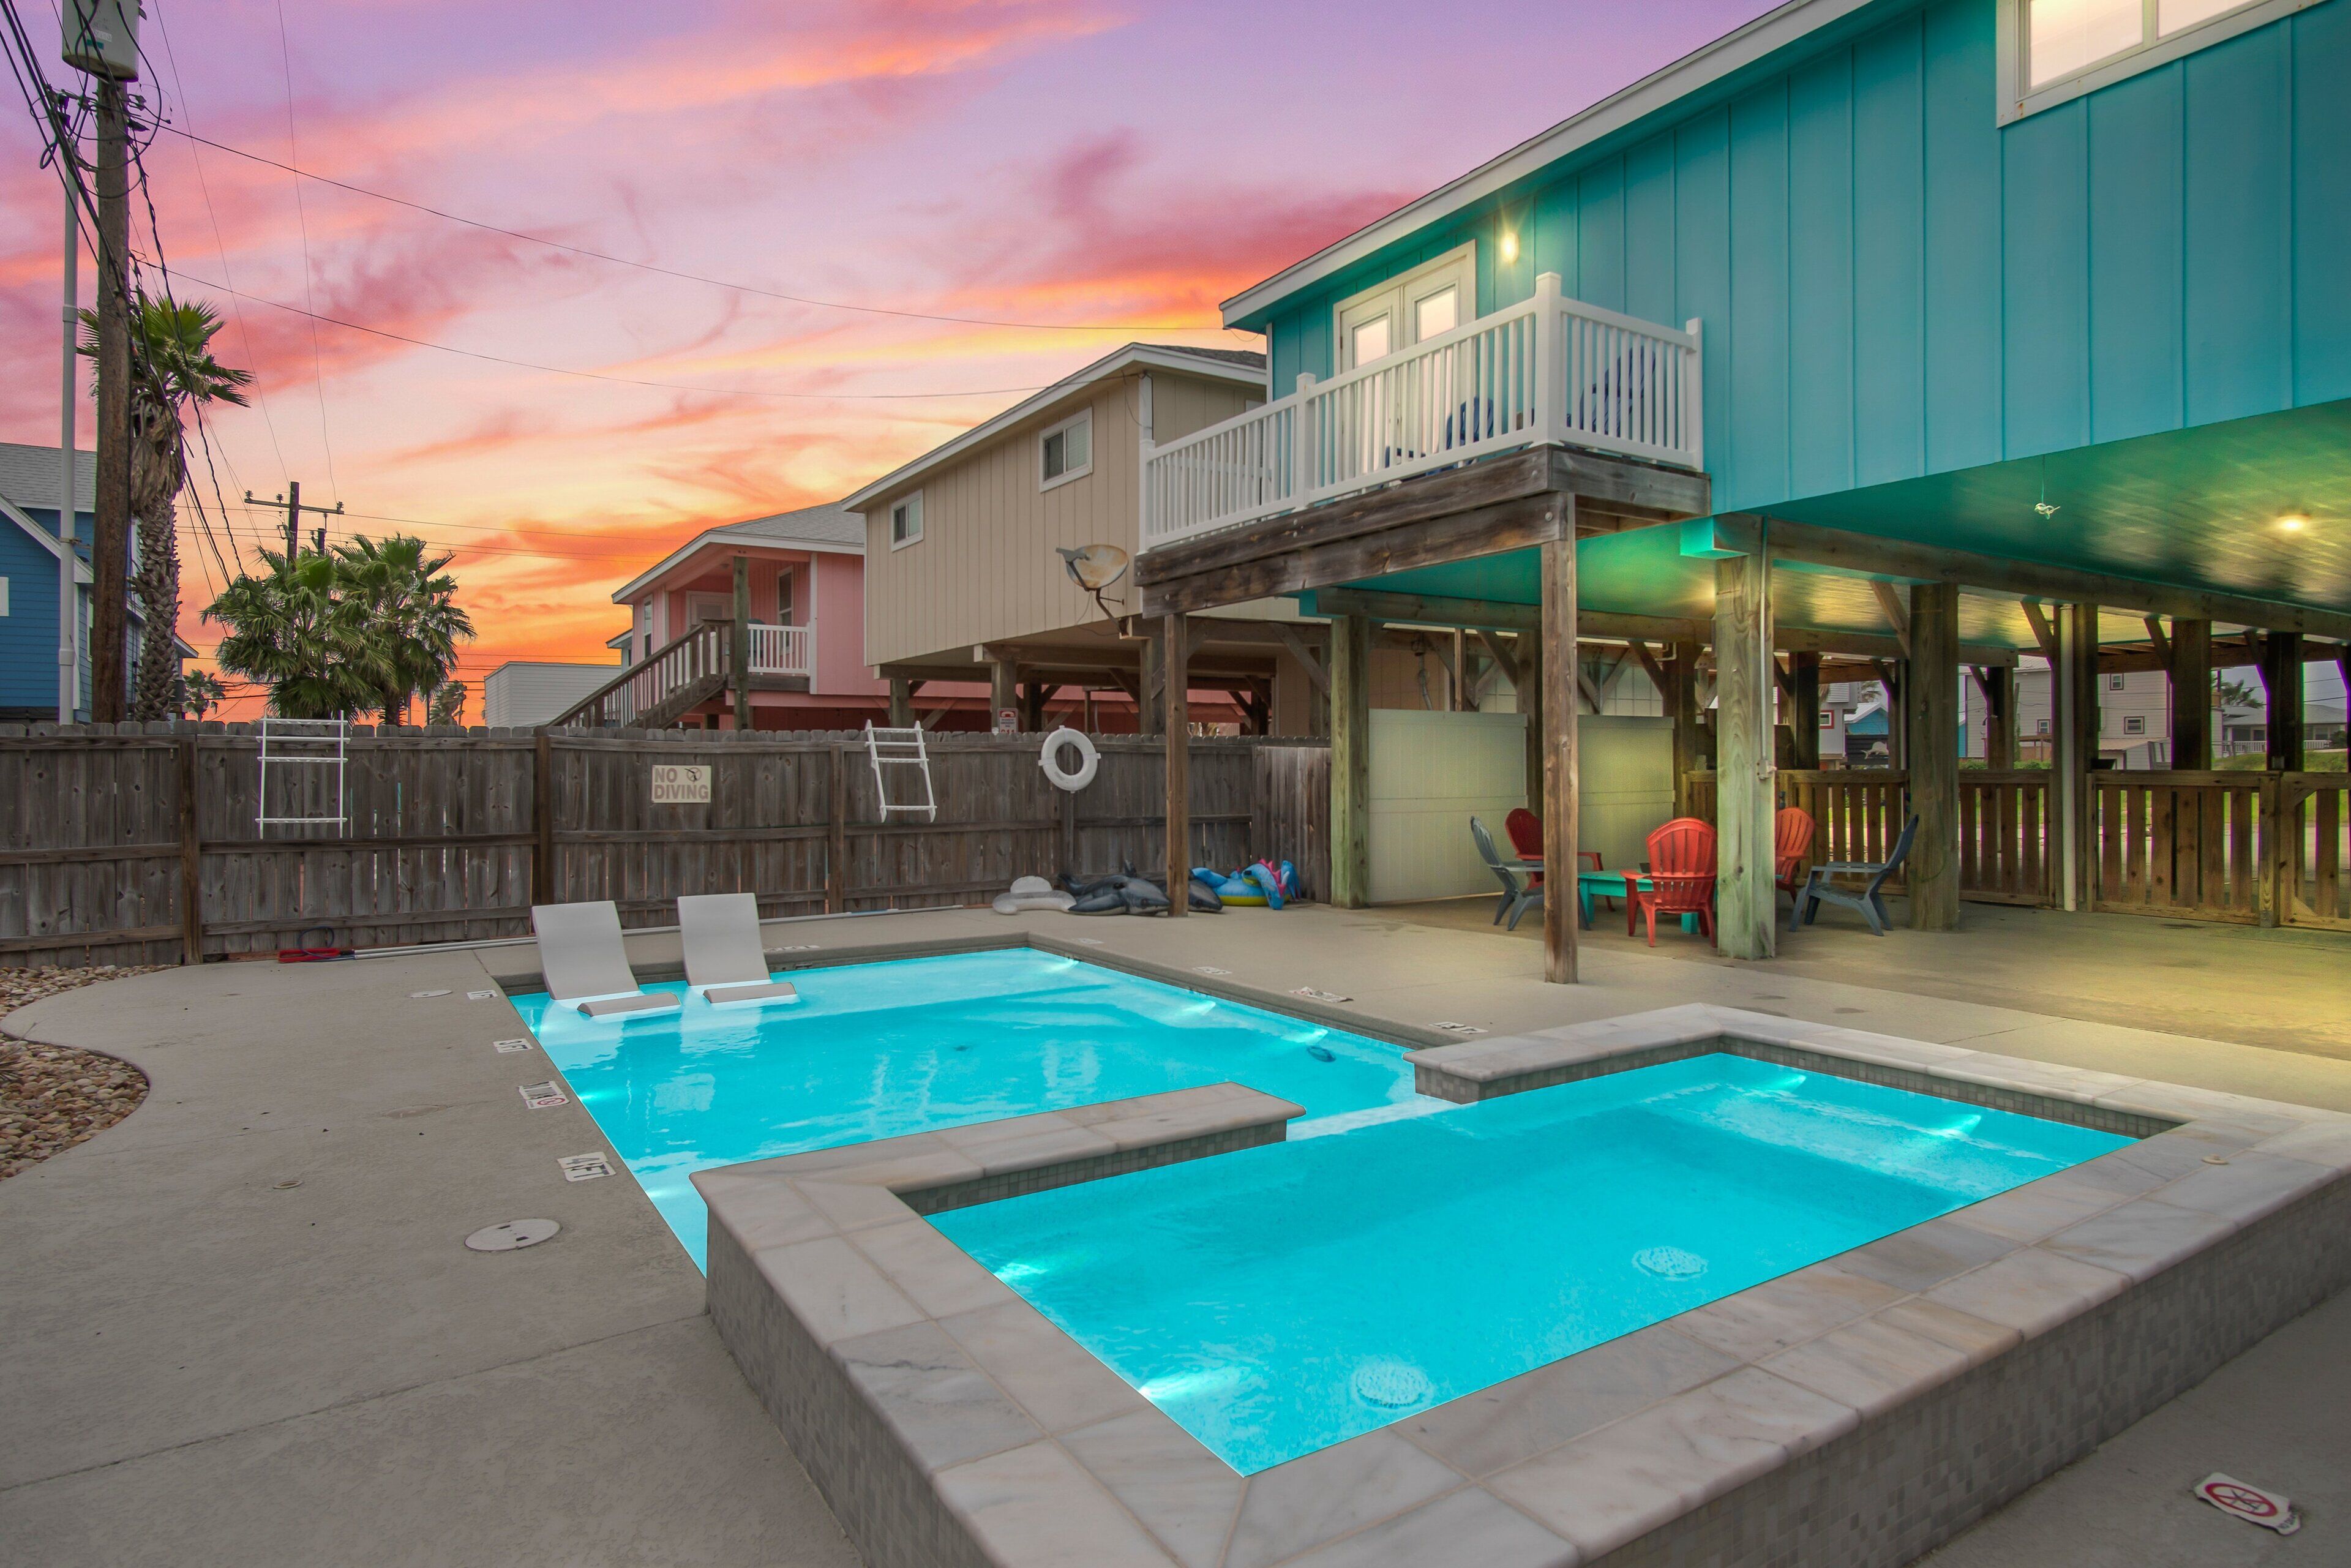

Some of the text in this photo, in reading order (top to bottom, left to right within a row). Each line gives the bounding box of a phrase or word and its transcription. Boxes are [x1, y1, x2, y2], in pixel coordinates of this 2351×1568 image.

[654, 768, 677, 782] NO
[654, 784, 708, 799] DIVING
[571, 1164, 610, 1179] FT
